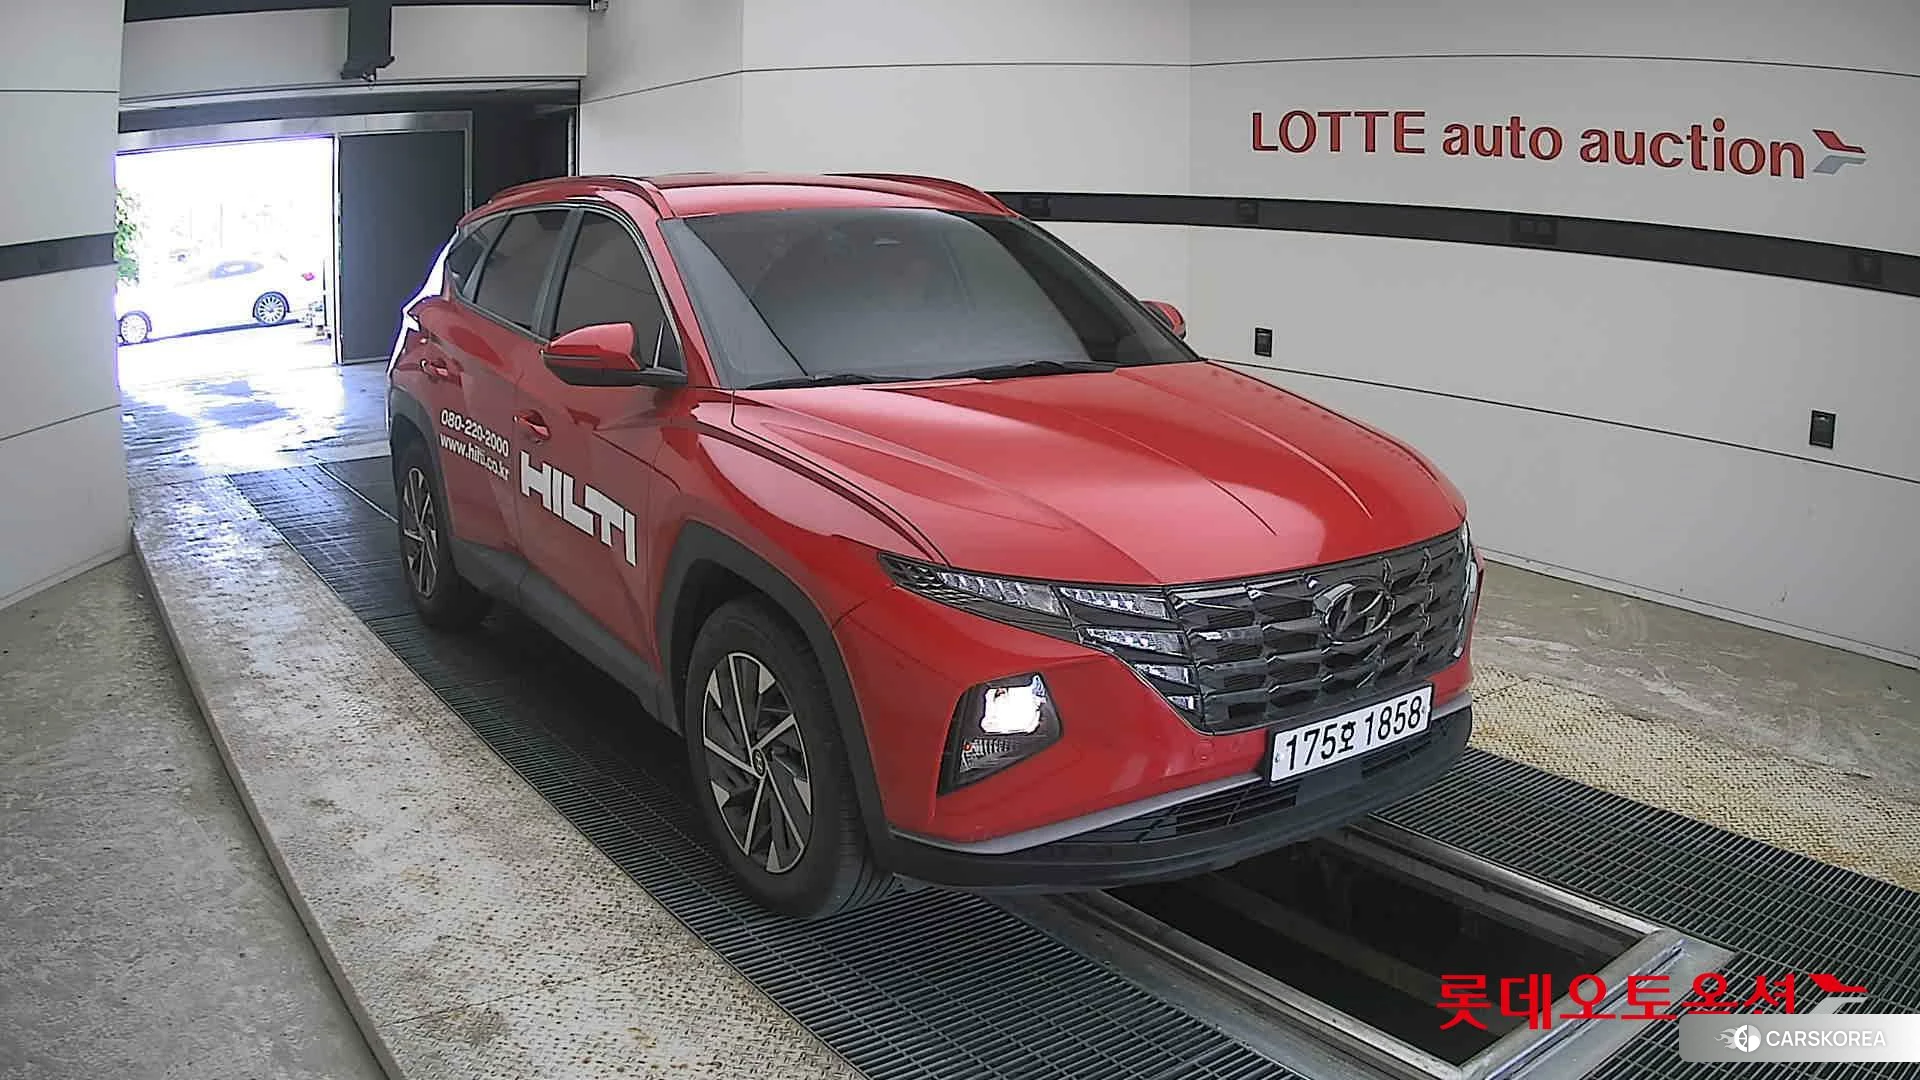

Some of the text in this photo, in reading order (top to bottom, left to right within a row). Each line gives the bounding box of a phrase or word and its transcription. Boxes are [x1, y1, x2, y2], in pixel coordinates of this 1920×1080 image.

[1252, 110, 1805, 179] LOTTE auto auction
[441, 408, 510, 457] 080-220-2000
[519, 450, 637, 568] HILTI
[1286, 696, 1422, 770] 175호 1858
